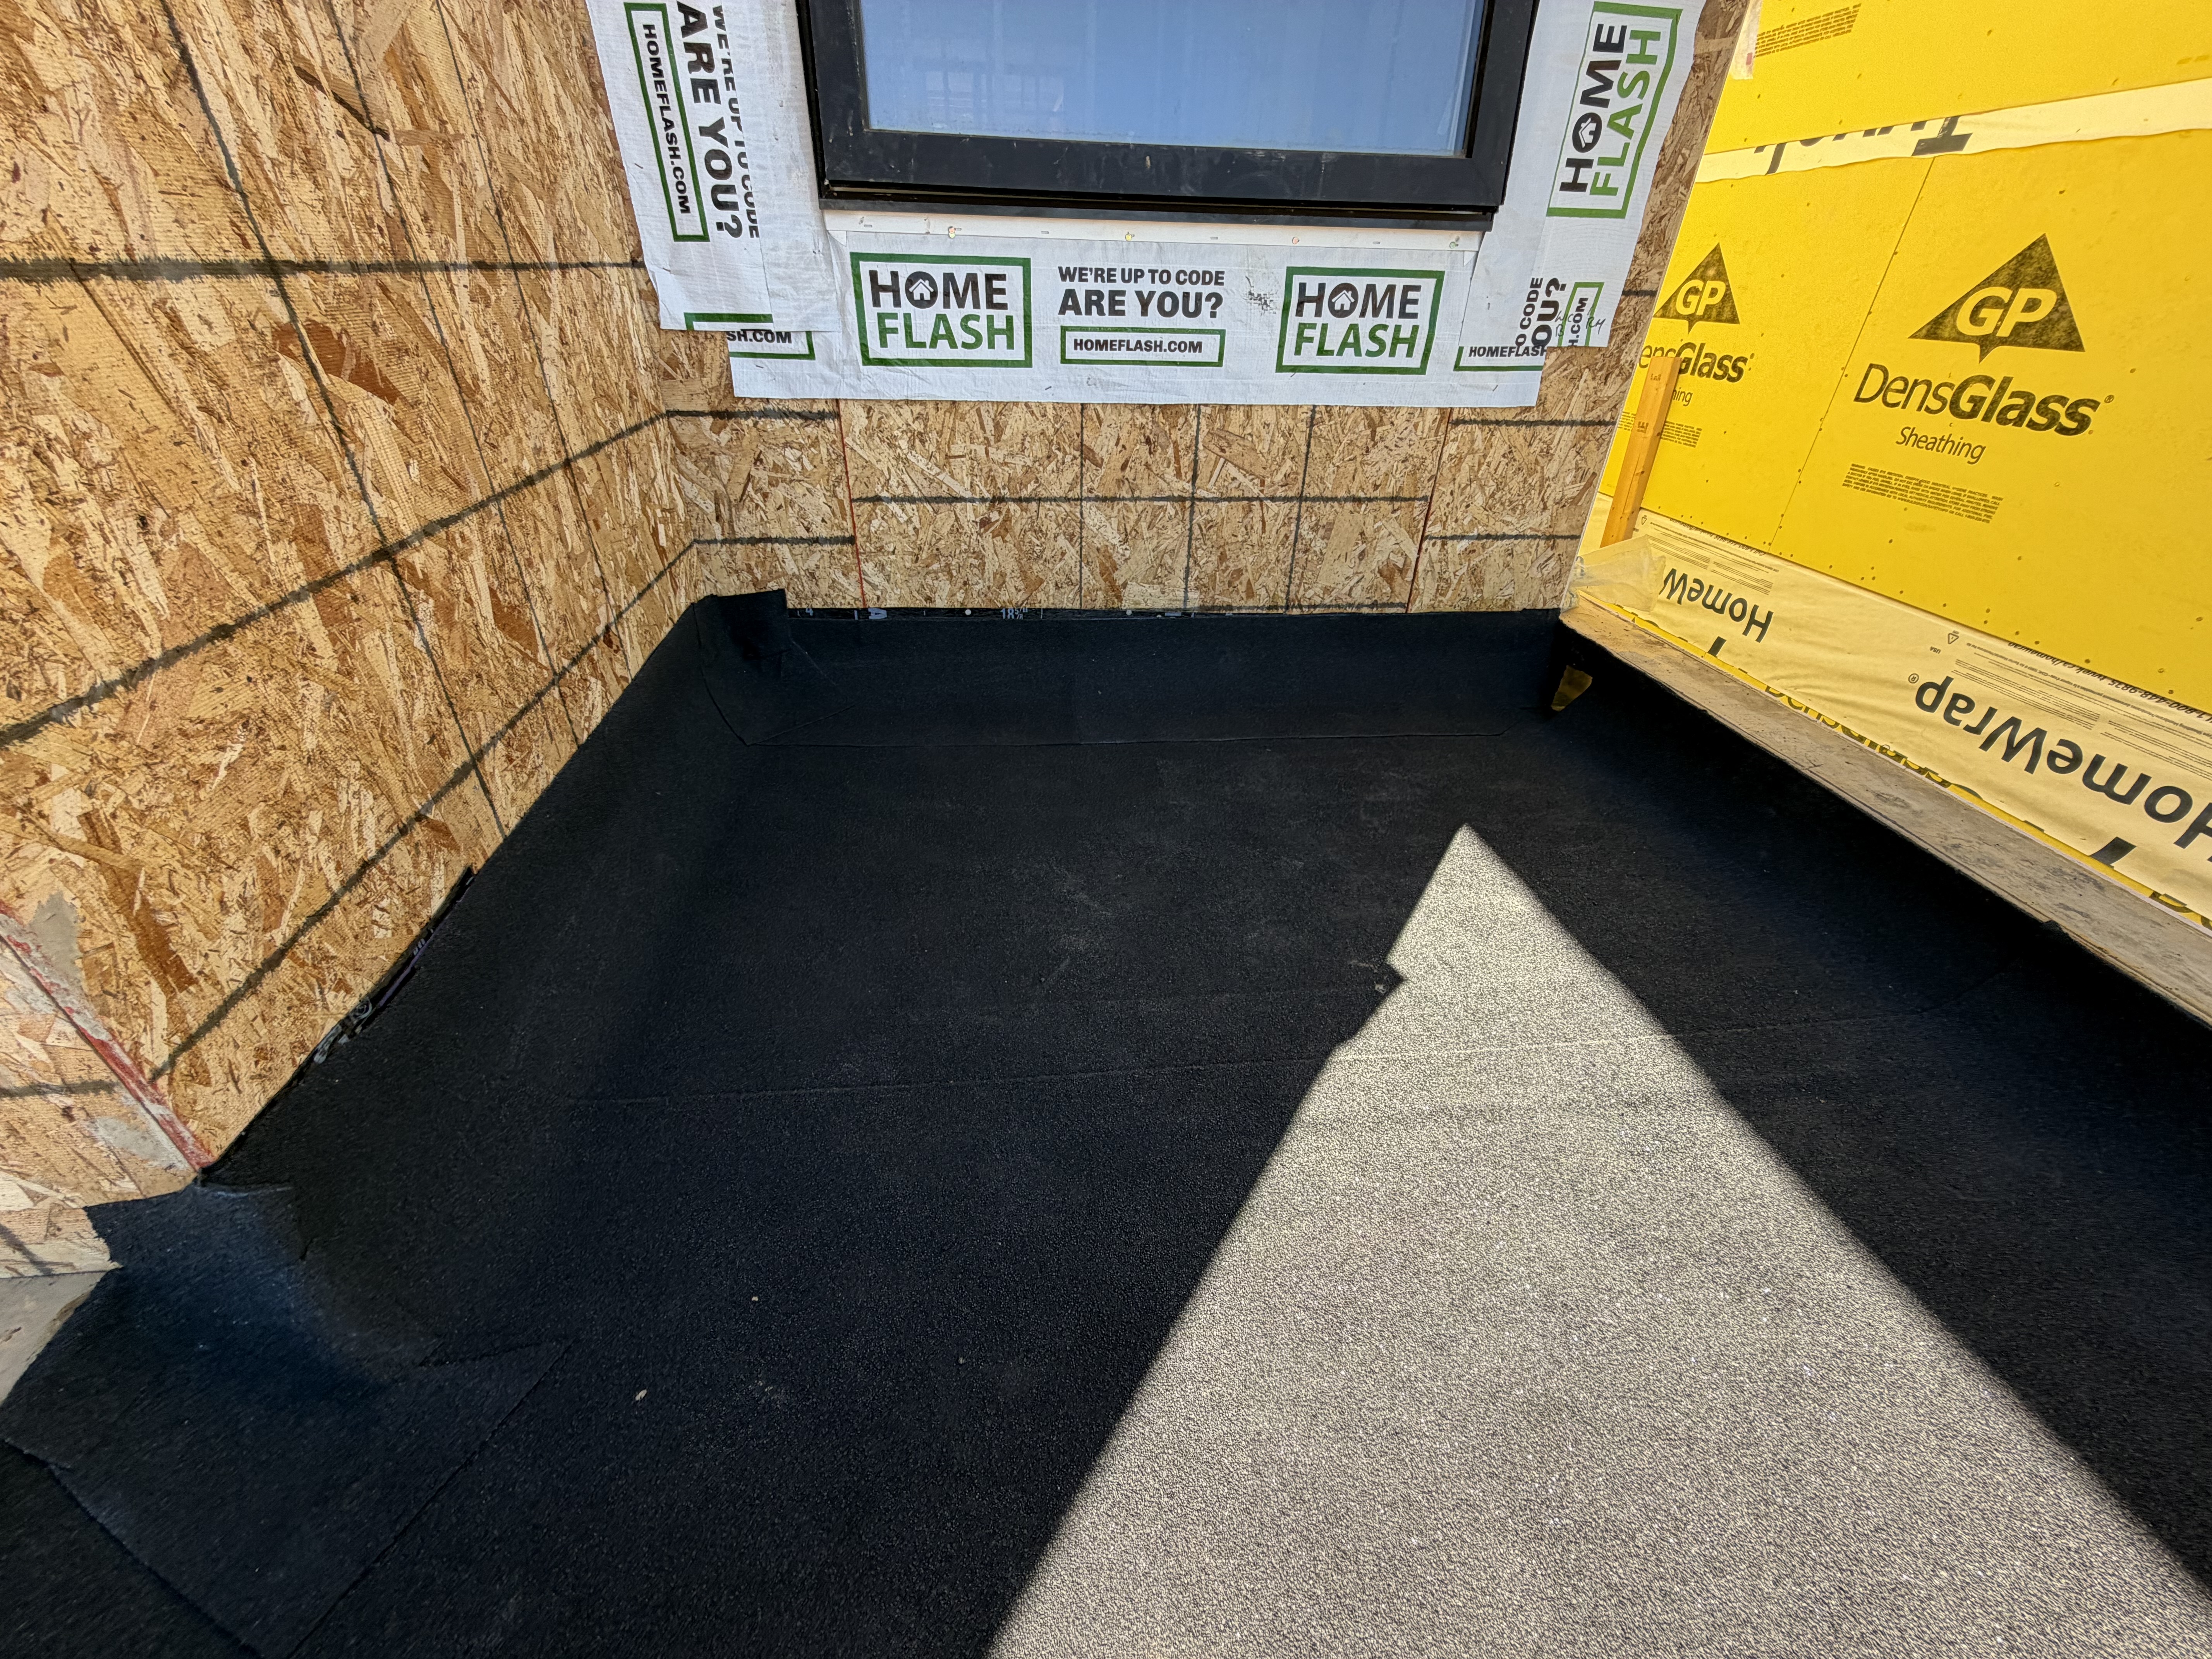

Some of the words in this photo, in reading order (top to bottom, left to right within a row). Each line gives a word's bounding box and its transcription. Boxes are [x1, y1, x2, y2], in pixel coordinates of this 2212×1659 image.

[677, 0, 722, 105] ARE
[642, 24, 691, 214] HOMEFLASH.COM
[1559, 24, 1627, 192] HOME
[1589, 30, 1661, 196] FLASH
[699, 116, 743, 238] YOU?
[869, 269, 1009, 311] HOME
[1058, 266, 1117, 283] WE'RE
[1121, 268, 1145, 284] UP
[1148, 269, 1172, 285] TO
[1175, 270, 1225, 286] CODE
[1058, 289, 1127, 316] ARE
[1134, 290, 1223, 318] YOU?
[1295, 281, 1422, 320] HOME
[1519, 277, 1544, 330] CODE
[1531, 278, 1567, 347] OU?
[1676, 279, 1726, 316] GP
[1956, 286, 2058, 338] GP
[877, 311, 1015, 350] FLASH
[1073, 338, 1202, 353] HOMEFLASH.COM
[1293, 321, 1421, 358] FLASH
[1896, 426, 1987, 465] Sheathing
